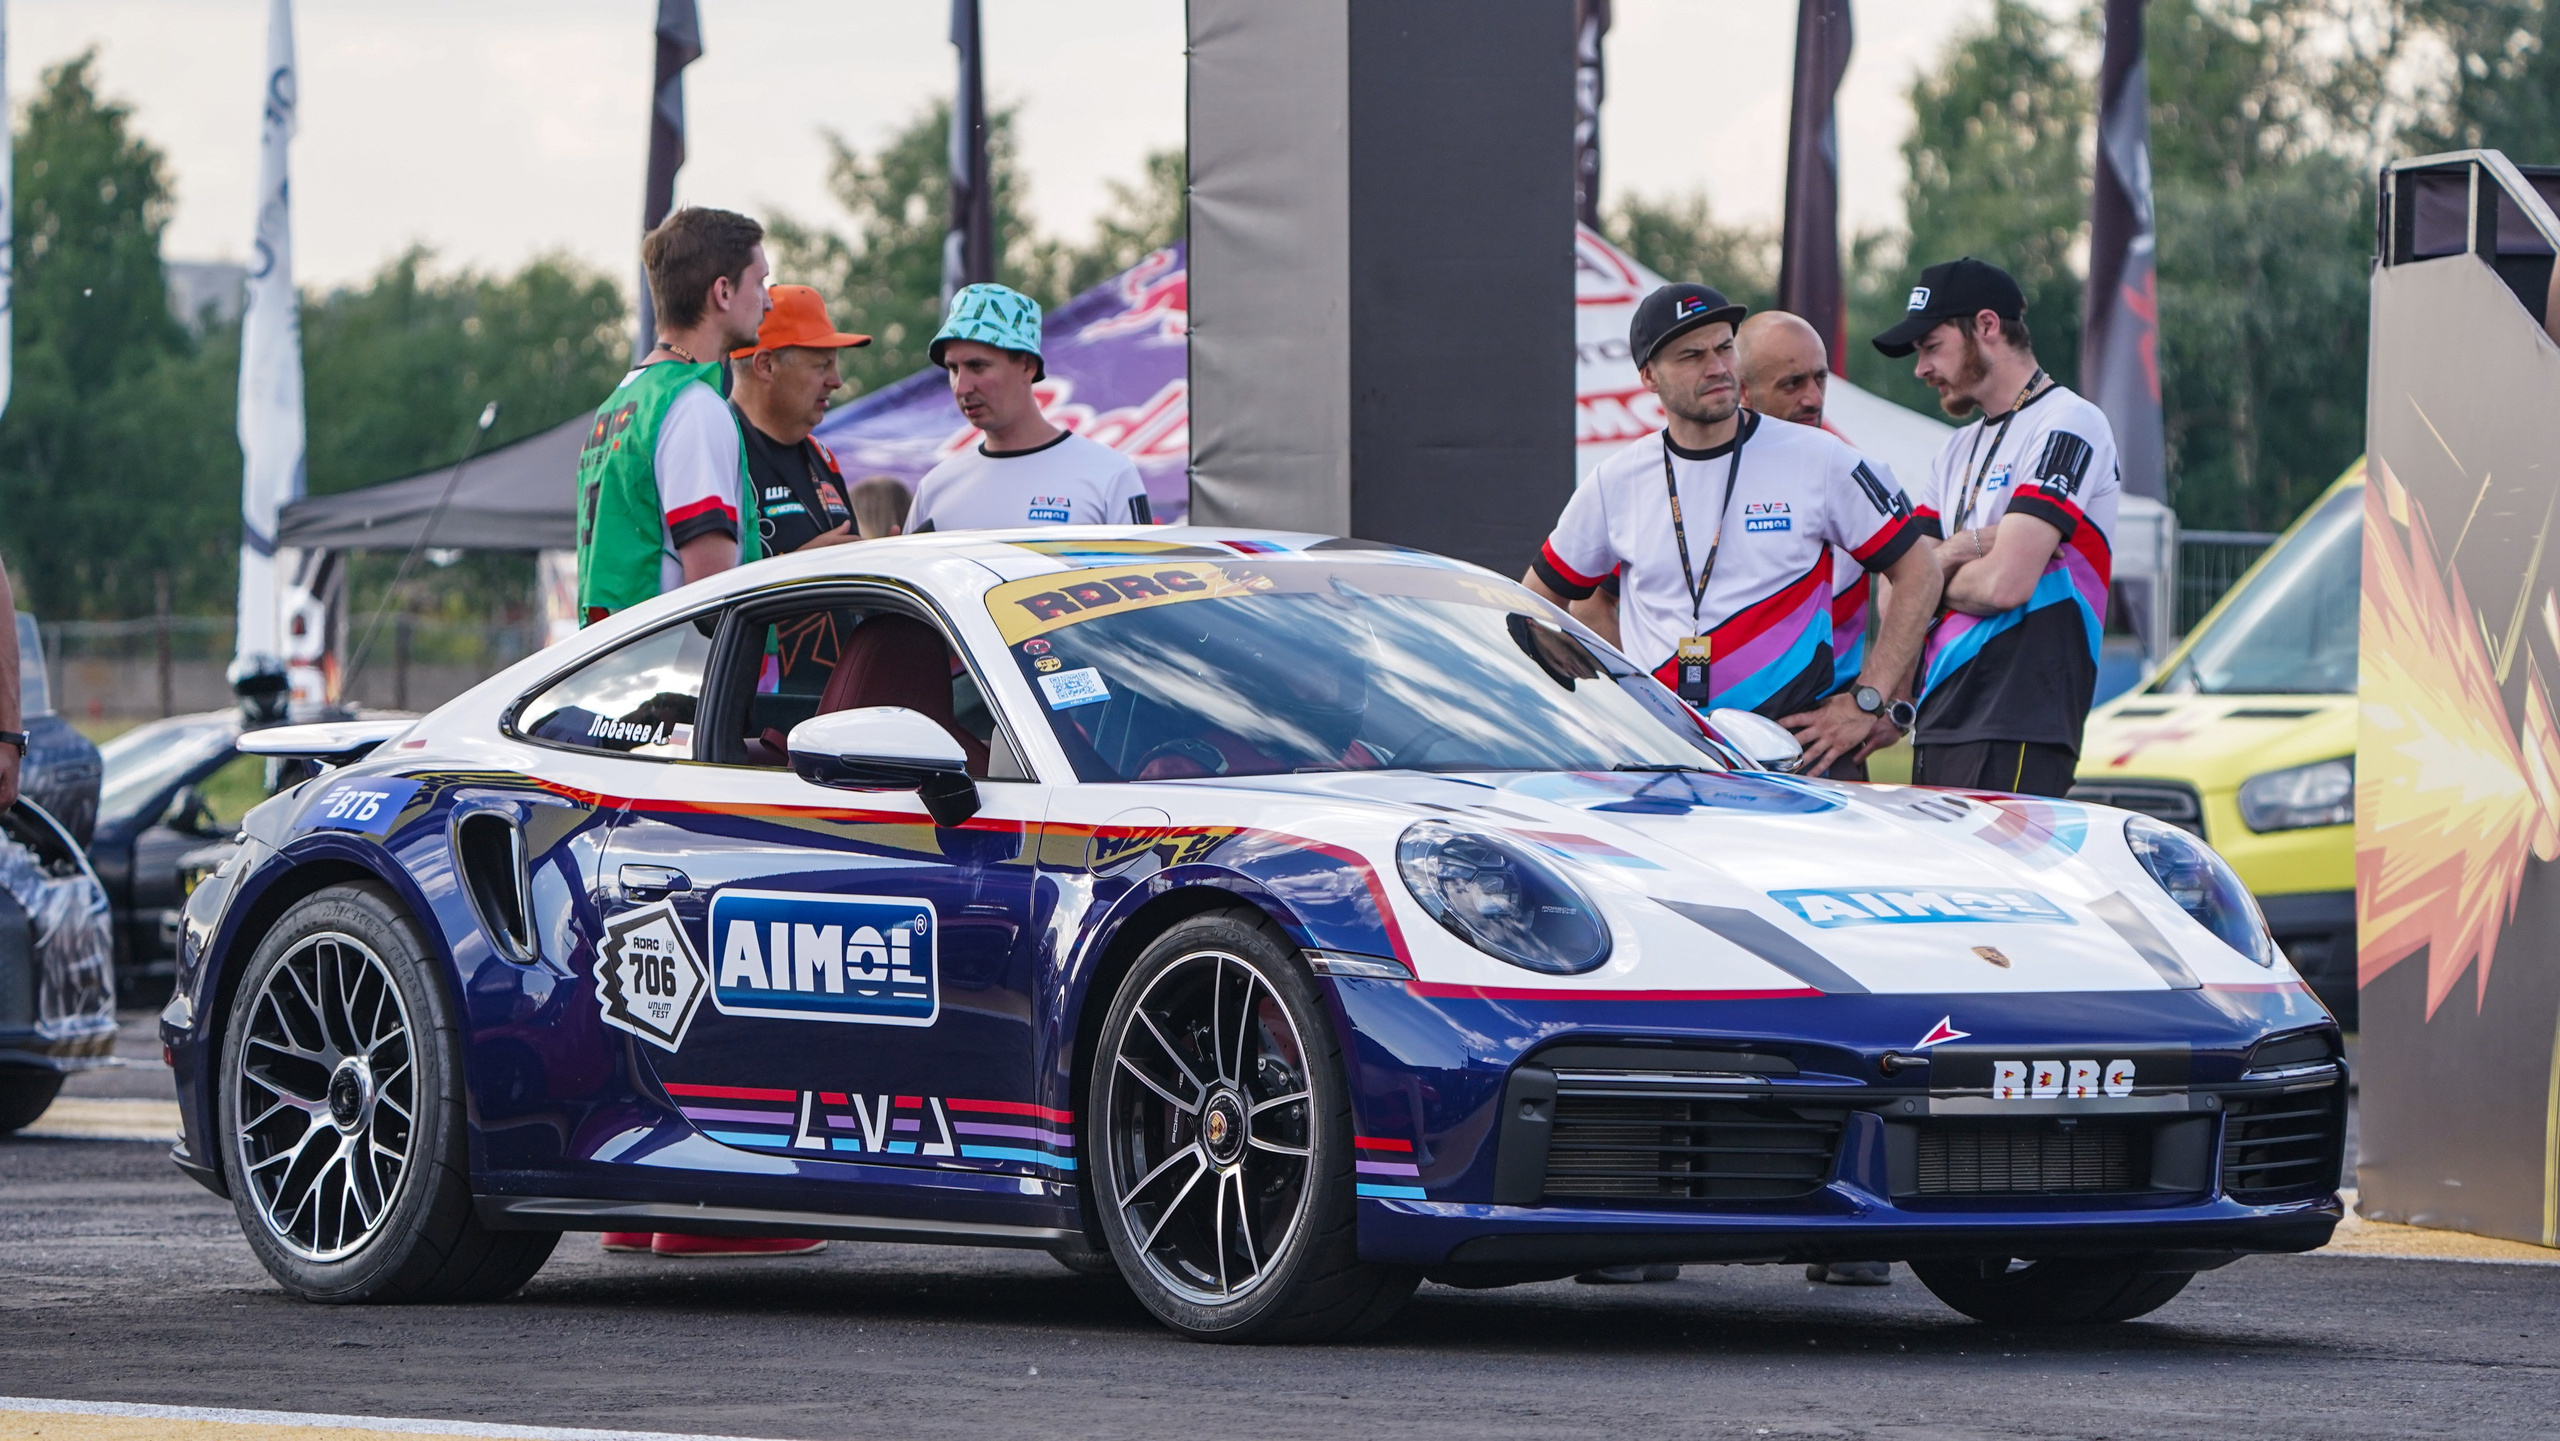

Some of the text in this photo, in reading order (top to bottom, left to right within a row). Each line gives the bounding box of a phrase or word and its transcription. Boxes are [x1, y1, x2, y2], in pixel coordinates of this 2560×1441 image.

[1029, 510, 1067, 520] AIMOL
[1748, 518, 1789, 531] AIMOL
[1014, 570, 1208, 622] RDRC
[587, 715, 651, 744] Лобачев
[326, 789, 391, 822] ВТБ
[1796, 891, 2067, 922] AIMOL
[633, 936, 660, 951] RDRC
[719, 919, 928, 999] AIMOL
[628, 953, 677, 997] 706
[651, 1009, 671, 1019] FEST
[1993, 1058, 2137, 1100] RDRC
